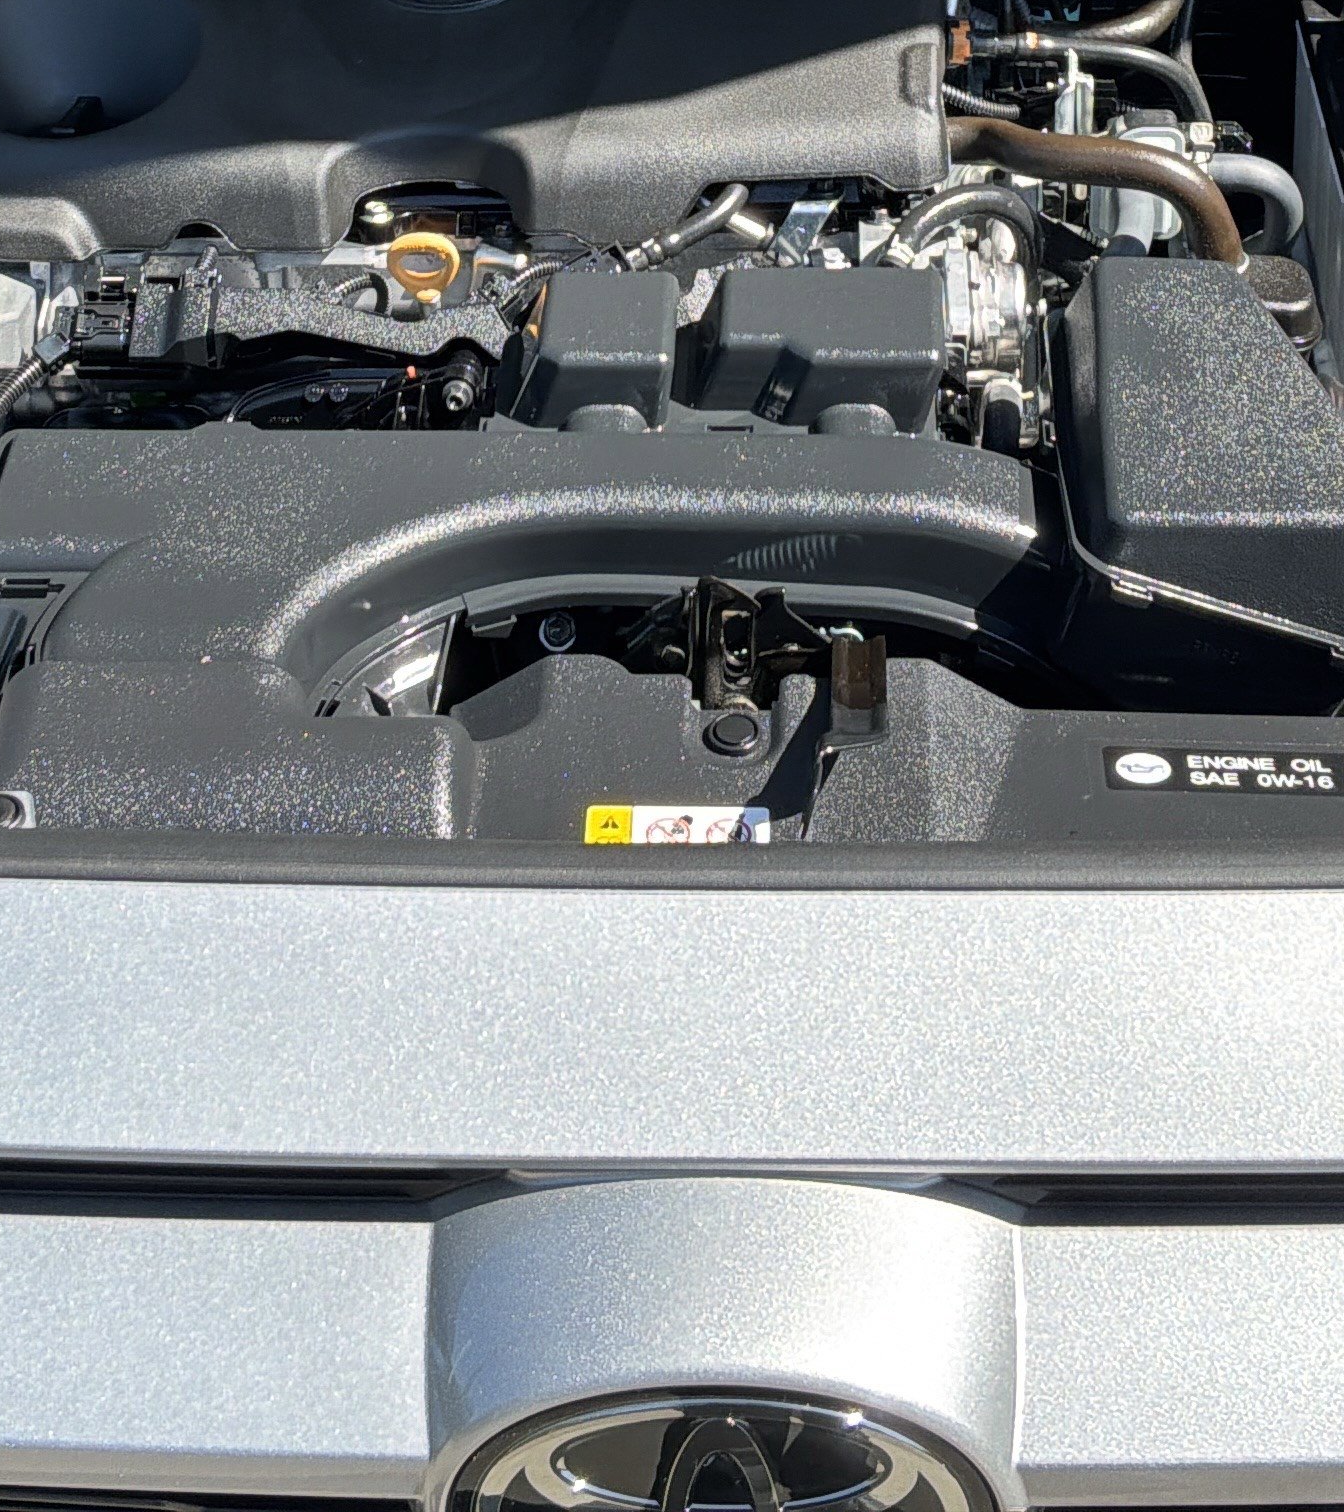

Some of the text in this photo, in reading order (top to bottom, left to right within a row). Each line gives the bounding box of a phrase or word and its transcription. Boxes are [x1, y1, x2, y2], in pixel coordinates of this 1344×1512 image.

[1186, 754, 1333, 774] ENGINE OIL
[1189, 770, 1335, 790] SAE 0W-16
